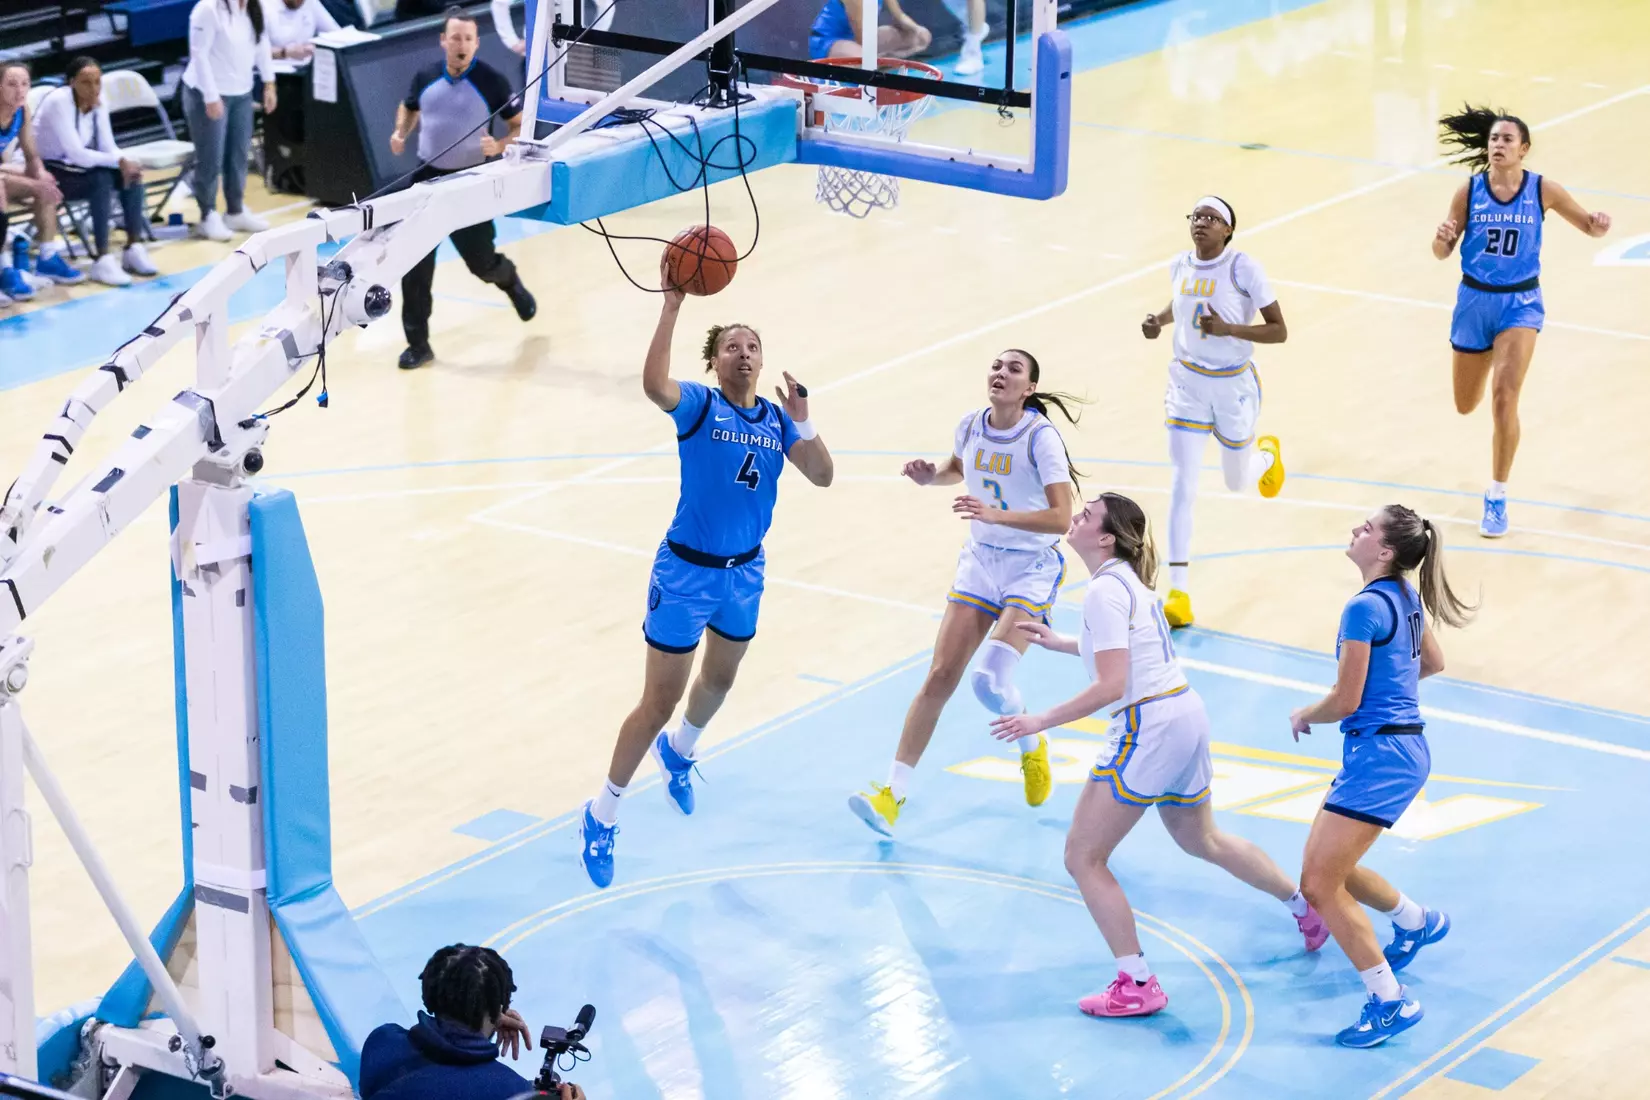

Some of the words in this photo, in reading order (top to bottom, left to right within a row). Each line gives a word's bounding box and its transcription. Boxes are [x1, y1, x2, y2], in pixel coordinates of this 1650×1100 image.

[1474, 213, 1534, 225] COLUMBIA
[1484, 227, 1520, 258] 20
[1180, 277, 1216, 297] LIU
[712, 428, 783, 453] COLUMBIA
[734, 450, 761, 491] 4
[975, 448, 1014, 475] LIU
[983, 478, 1009, 511] 3
